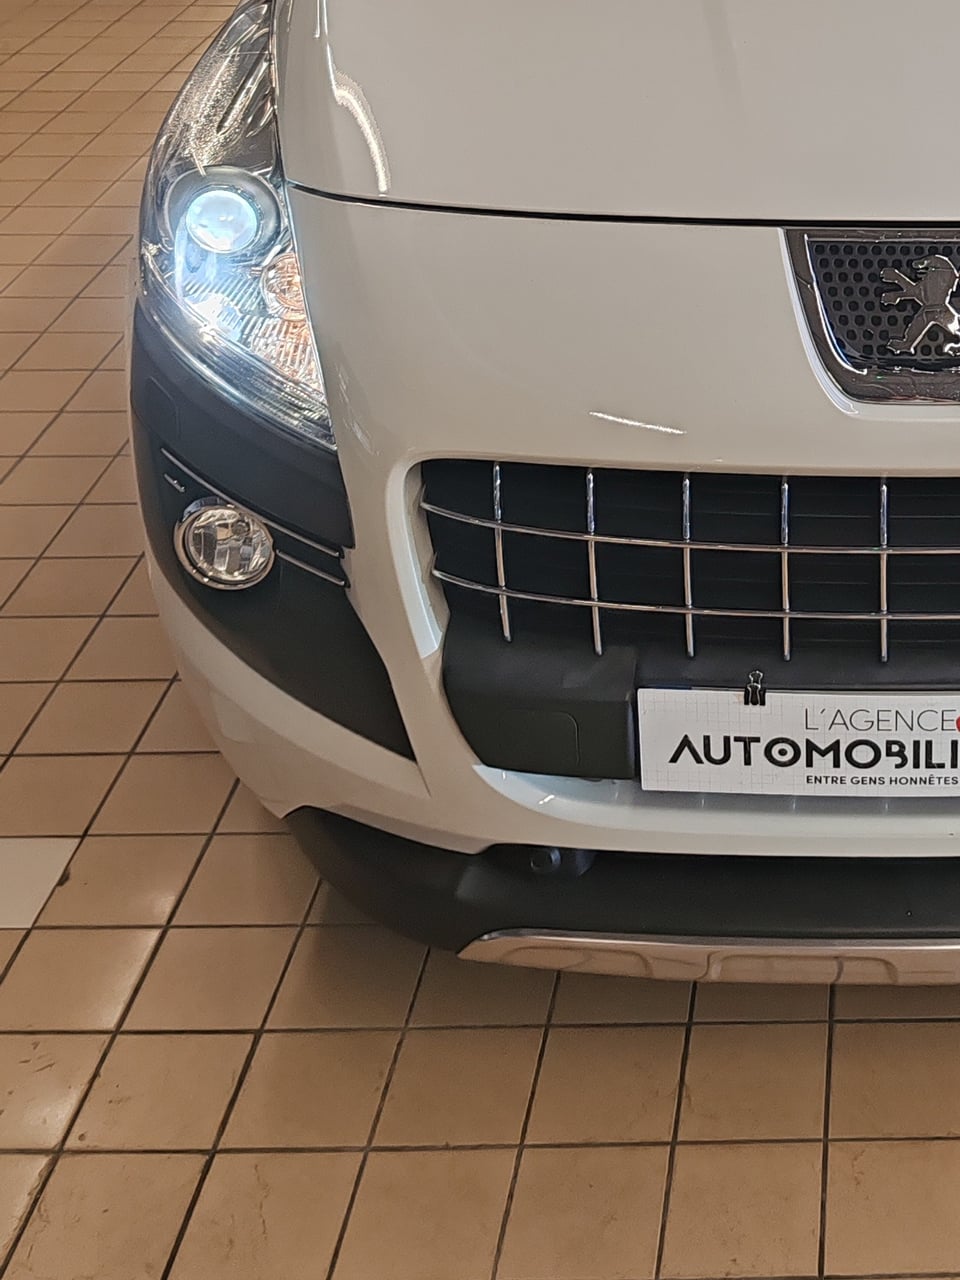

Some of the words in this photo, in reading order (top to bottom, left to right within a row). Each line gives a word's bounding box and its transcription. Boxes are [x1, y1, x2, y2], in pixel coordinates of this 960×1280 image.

[805, 708, 957, 732] L'AGENCE
[806, 775, 847, 785] ENTRE
[850, 776, 886, 785] GENS
[889, 773, 959, 785] HONNÊTES
